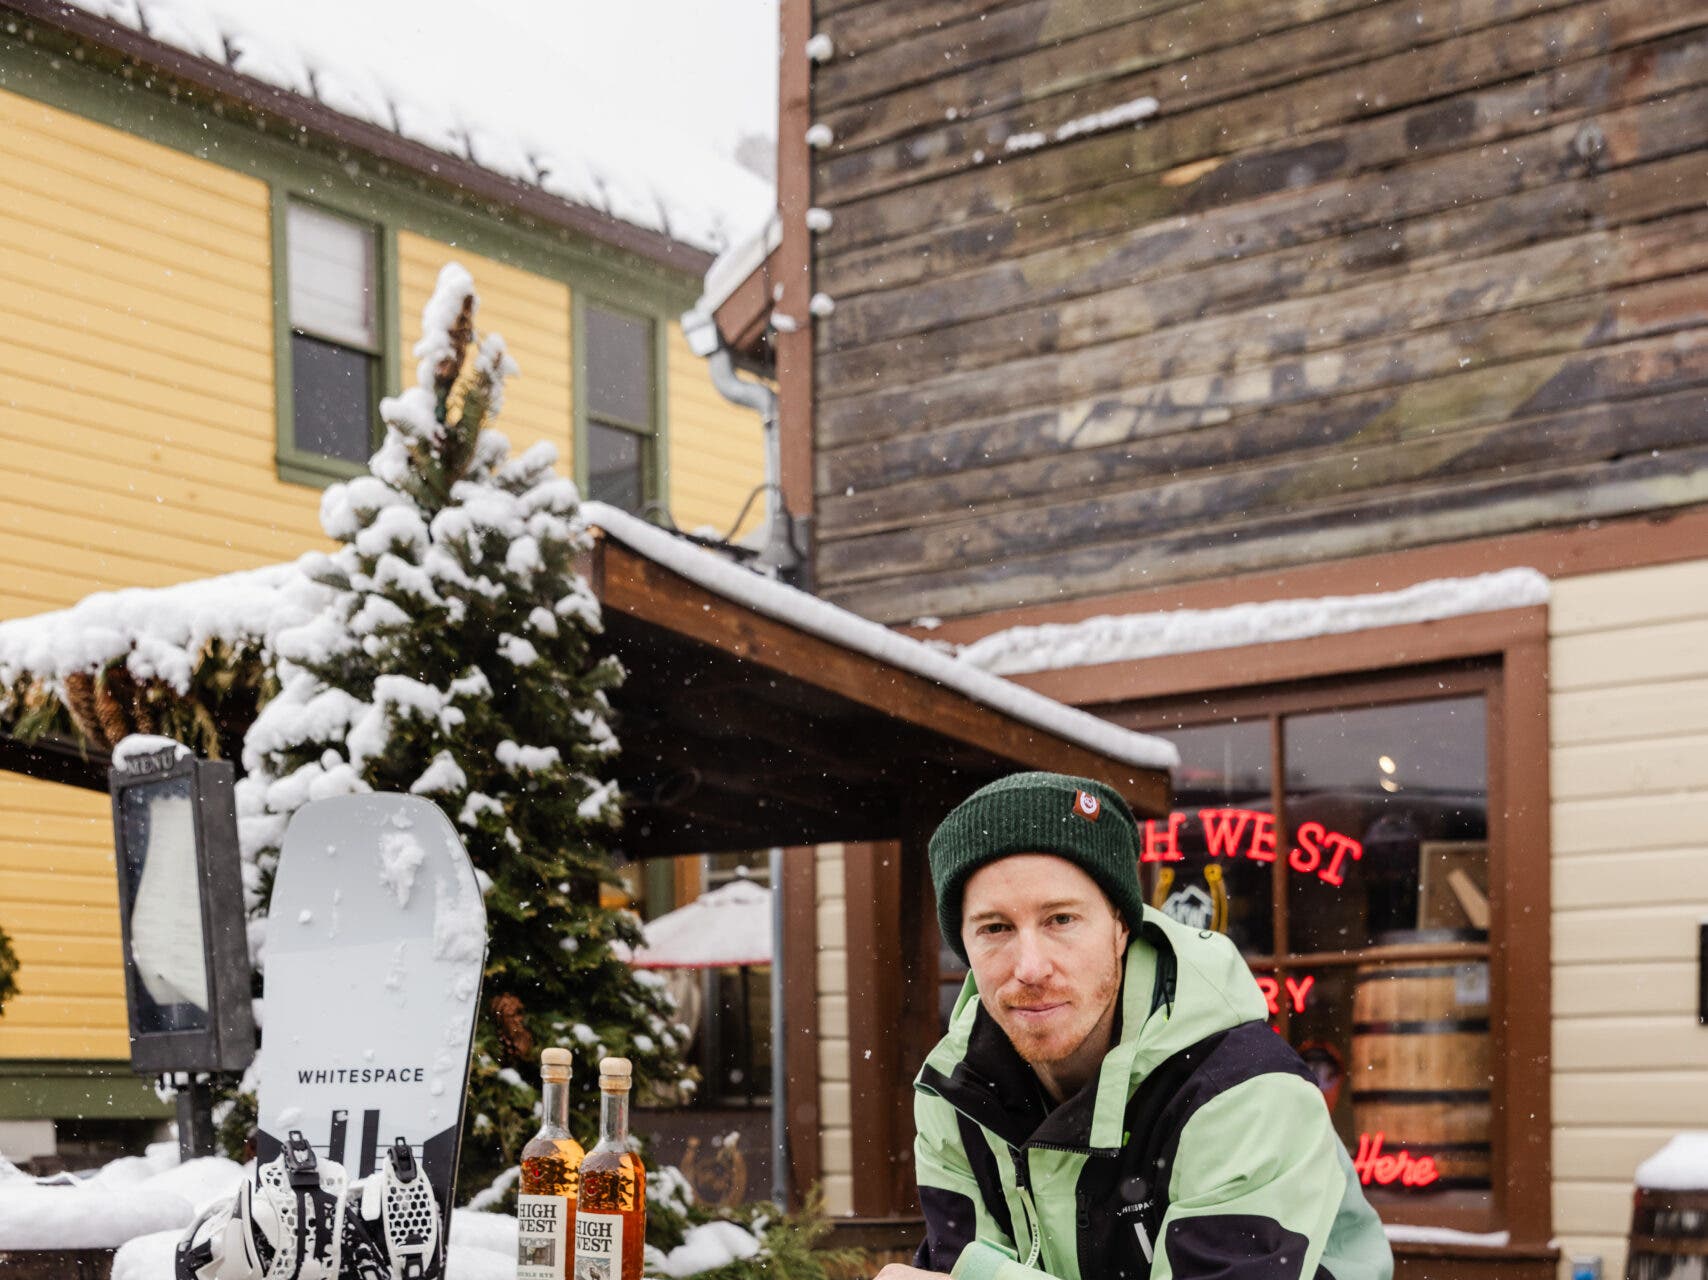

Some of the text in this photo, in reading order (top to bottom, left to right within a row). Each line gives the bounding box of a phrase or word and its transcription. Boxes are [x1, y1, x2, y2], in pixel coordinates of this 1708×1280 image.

[1197, 808, 1364, 887] WEST
[298, 1068, 424, 1084] WHITESPACE
[1354, 1131, 1439, 1187] Here
[519, 1203, 557, 1219] HIGH
